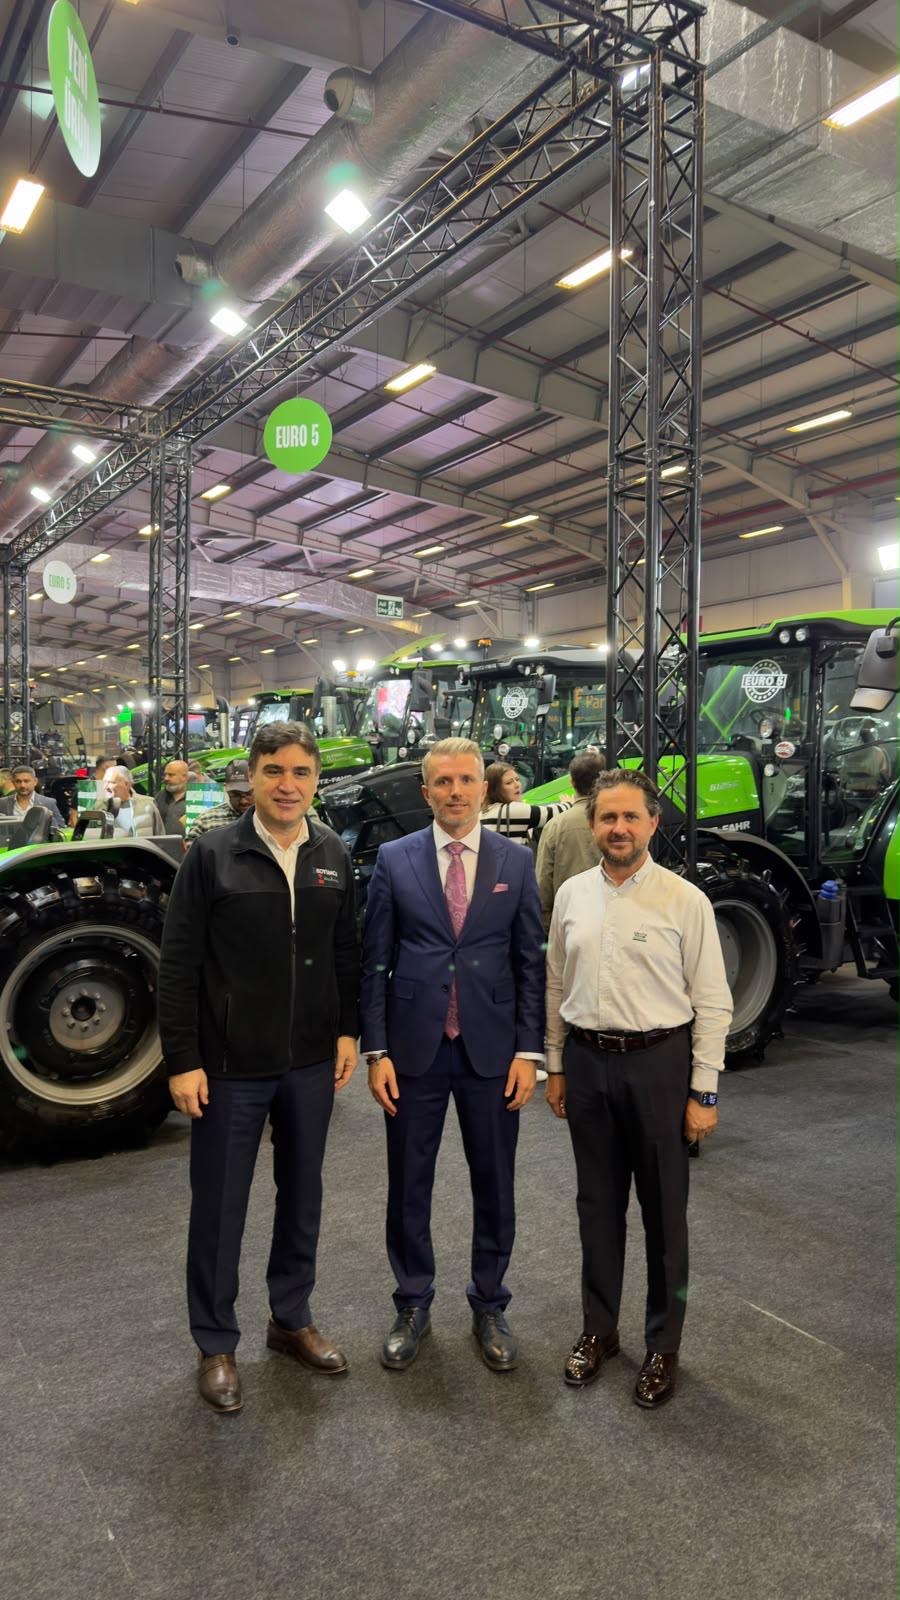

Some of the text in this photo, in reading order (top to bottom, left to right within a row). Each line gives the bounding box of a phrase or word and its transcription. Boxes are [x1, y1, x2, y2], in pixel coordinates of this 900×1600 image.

[275, 423, 319, 449] EURO 5
[48, 574, 65, 590] EURO
[744, 676, 785, 686] EURO 5
